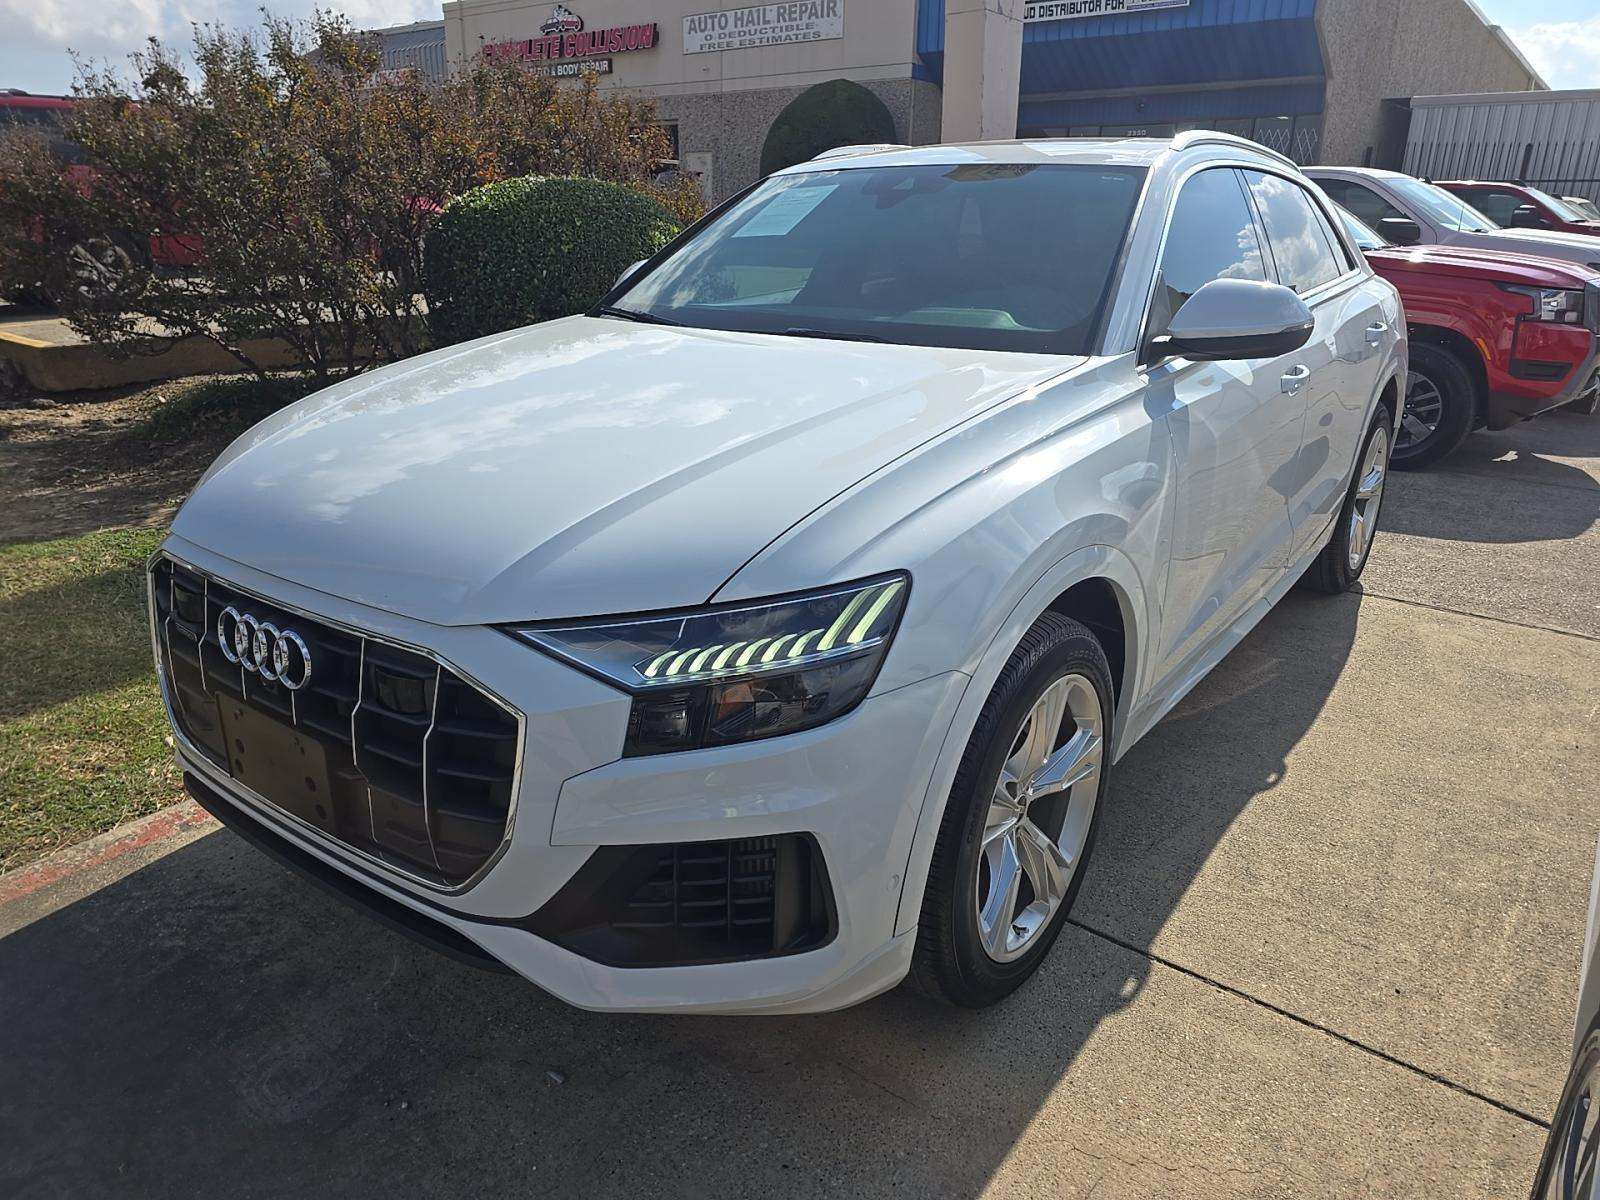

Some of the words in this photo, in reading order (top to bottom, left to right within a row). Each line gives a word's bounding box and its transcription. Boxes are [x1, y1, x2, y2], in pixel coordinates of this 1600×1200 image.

[687, 13, 729, 35] AUTO
[733, 8, 771, 28] HAIL
[776, 0, 839, 23] REPAIR
[1038, 0, 1102, 18] DISTRIBUTOR
[1104, 0, 1125, 11] FOR
[564, 23, 654, 58] COLLISION
[718, 22, 815, 40] DEDUCTIBLE
[700, 40, 735, 51] FREE
[739, 31, 822, 46] ESTIMATES
[557, 63, 579, 76] BODY
